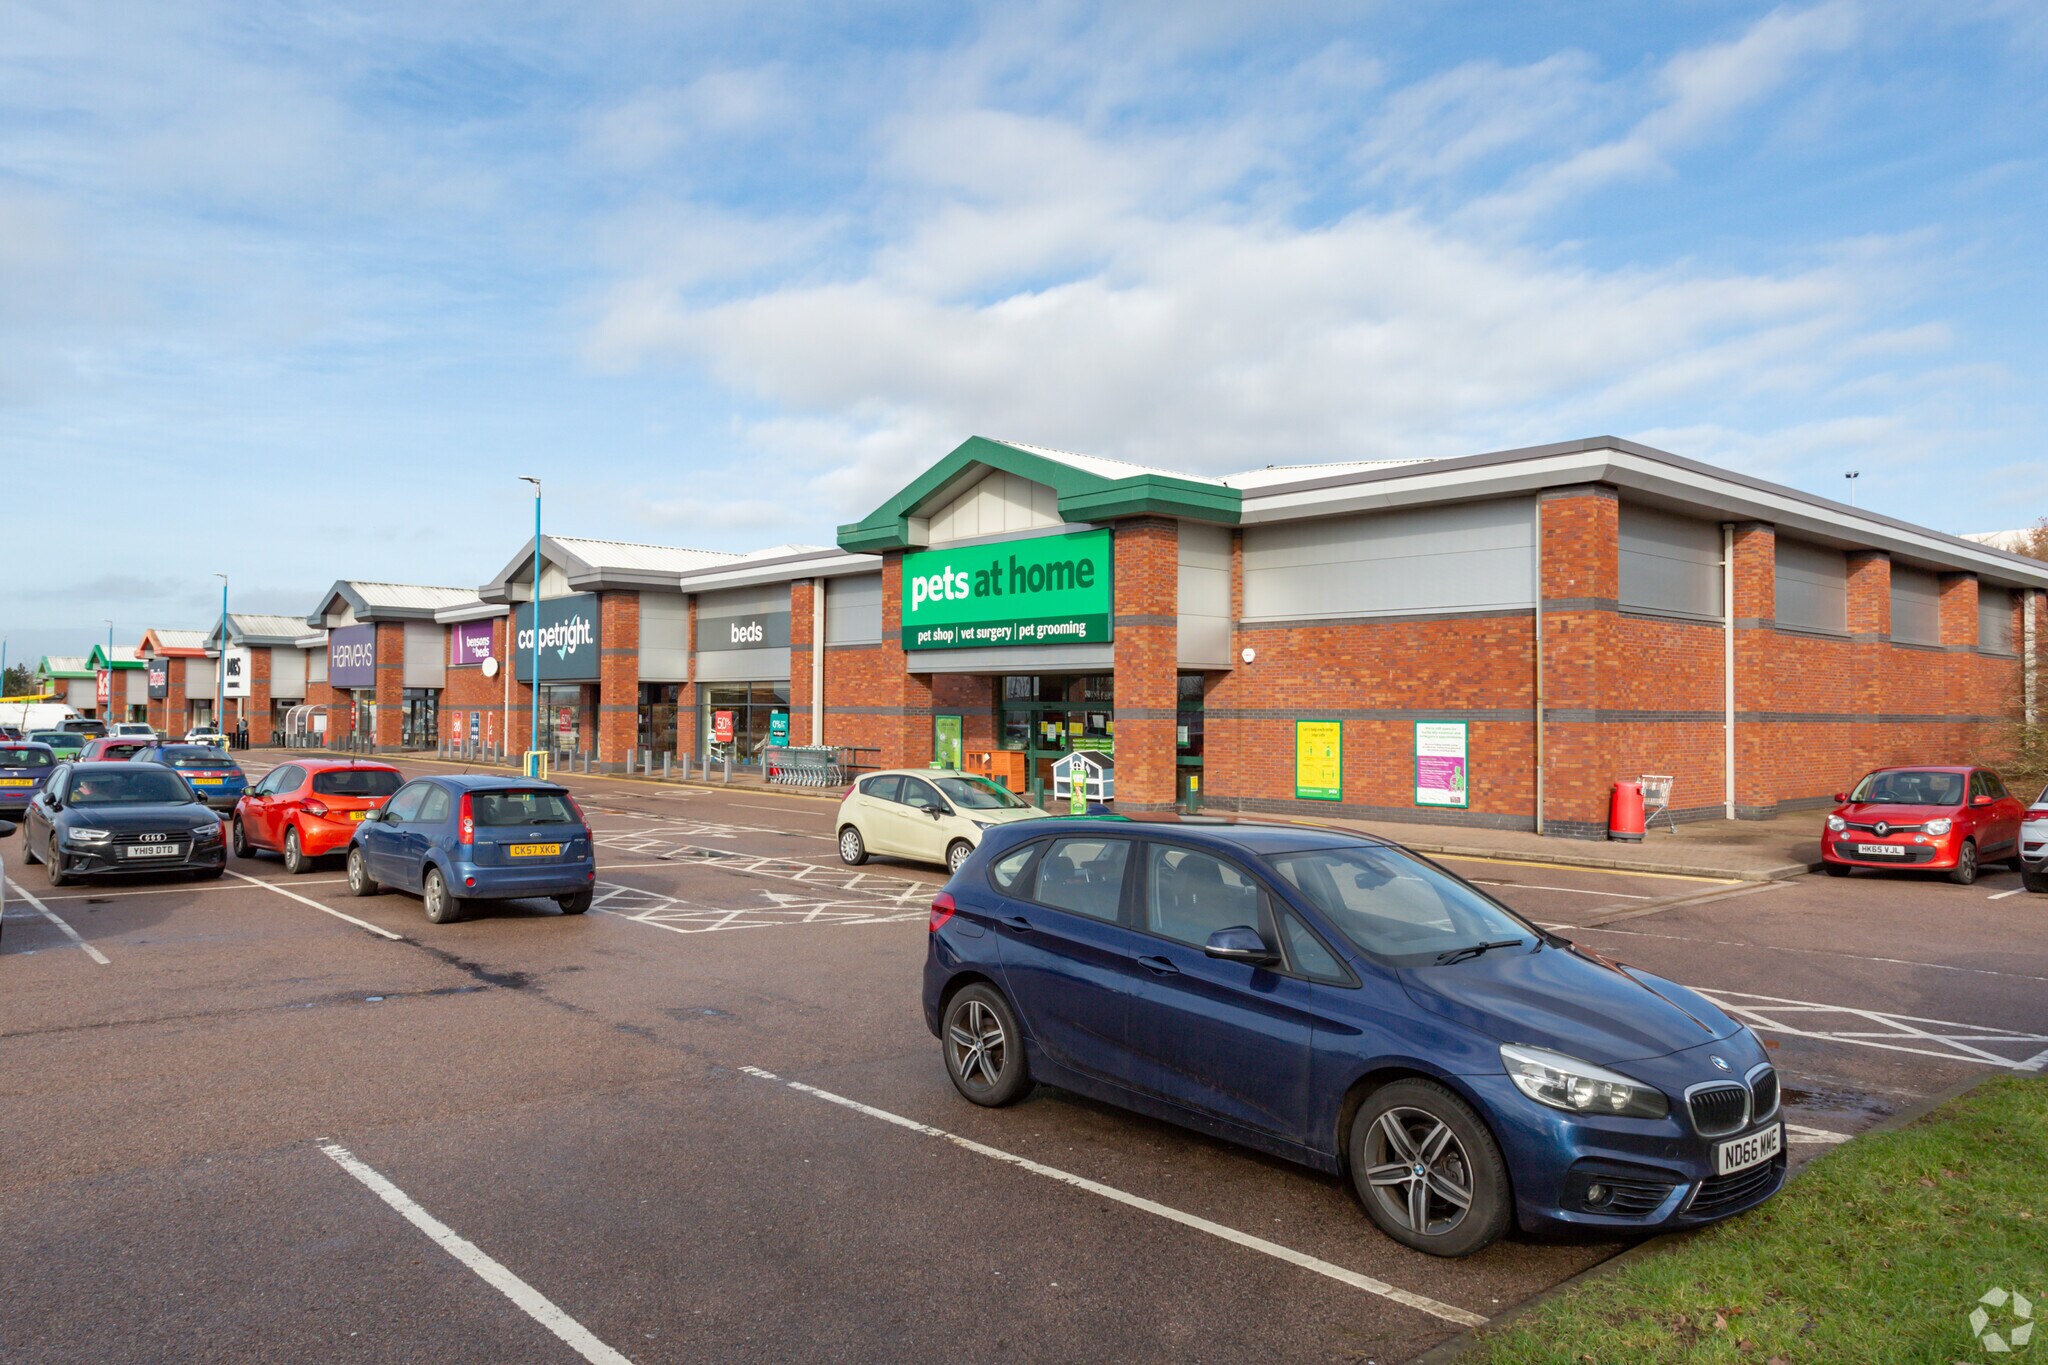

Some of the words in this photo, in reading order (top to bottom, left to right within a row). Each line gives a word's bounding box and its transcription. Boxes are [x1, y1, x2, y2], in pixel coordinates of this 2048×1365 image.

[912, 565, 970, 612] pets
[974, 560, 1003, 598] at
[1009, 554, 1095, 595] home
[518, 616, 594, 656] capetright.
[731, 621, 763, 643] beds
[918, 629, 932, 645] pet
[933, 627, 954, 643] shop
[961, 627, 975, 639] vet
[976, 626, 1012, 642] surgery
[1019, 622, 1035, 640] pet
[1036, 620, 1087, 640] grooming
[466, 635, 490, 648] bensons
[476, 645, 490, 658] beds
[133, 846, 154, 855] YH19
[155, 845, 174, 854] DTD
[514, 845, 537, 855] CK57
[539, 844, 557, 855] XKG
[1861, 845, 1882, 853] HK65
[1884, 846, 1901, 854] VJL
[1725, 1138, 1758, 1170] ND66
[1760, 1128, 1777, 1158] MME
